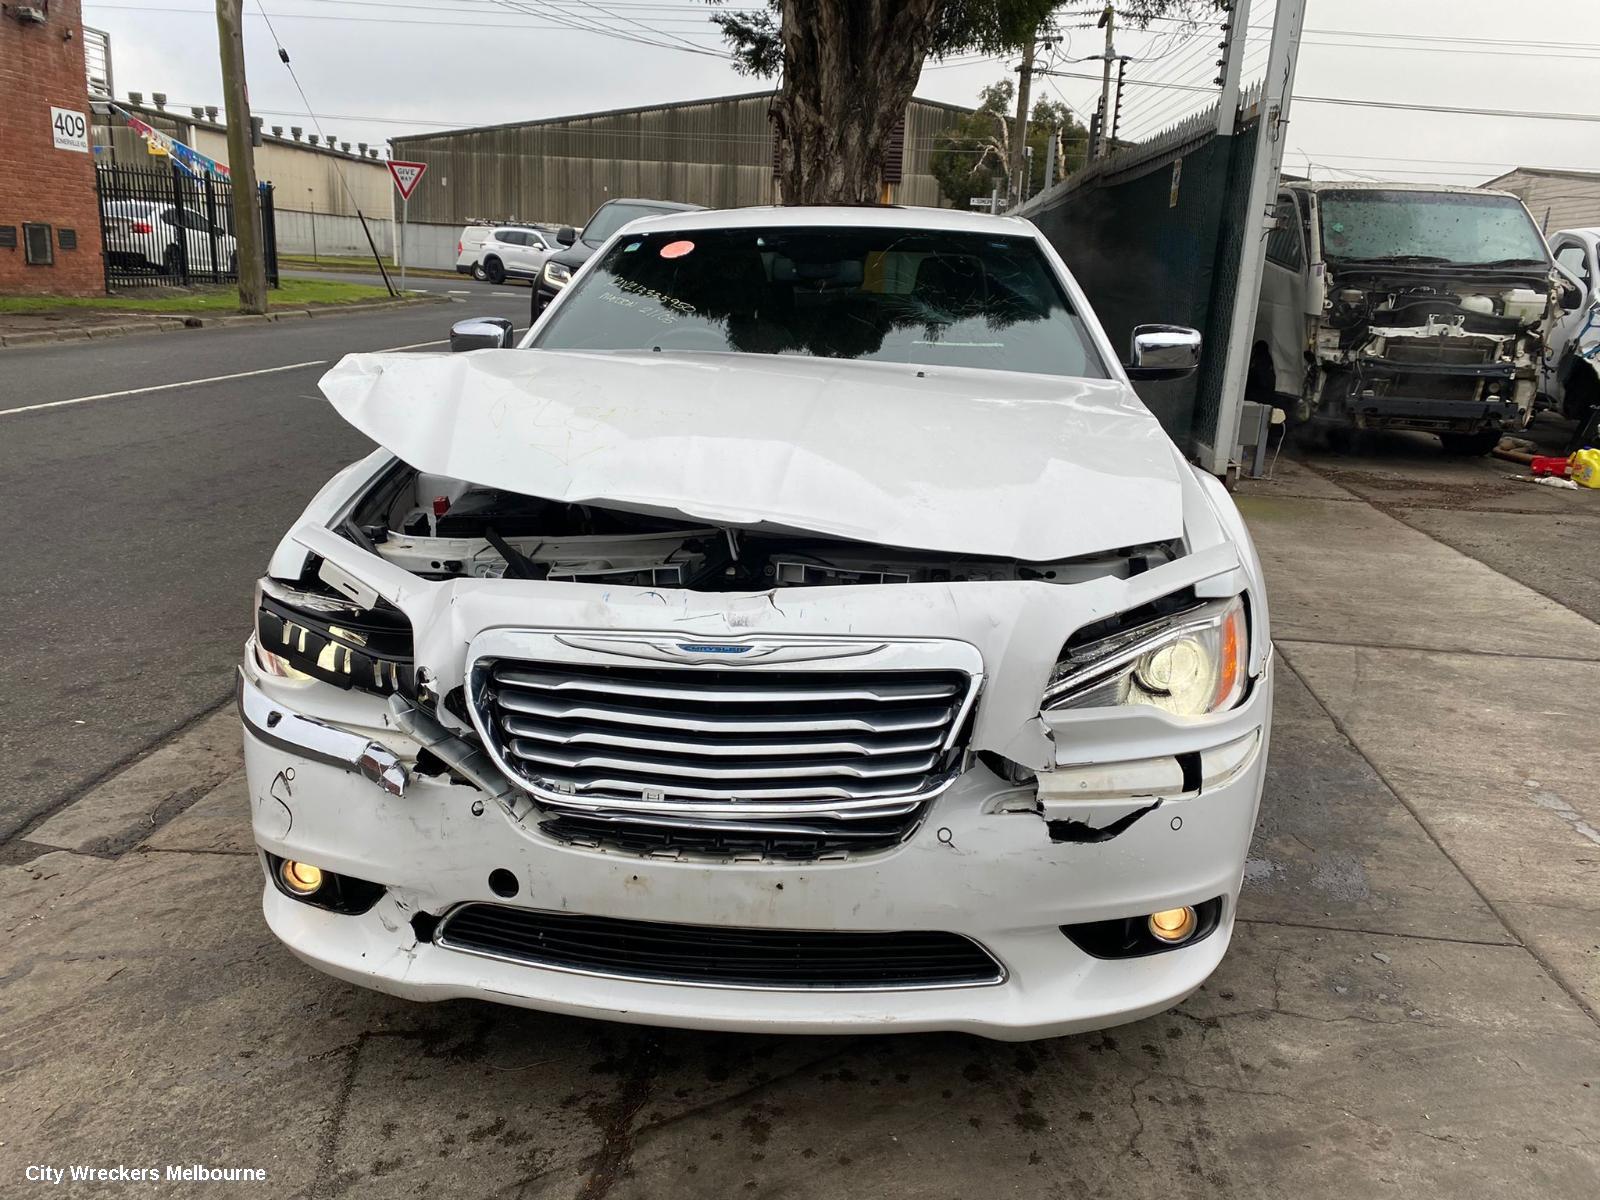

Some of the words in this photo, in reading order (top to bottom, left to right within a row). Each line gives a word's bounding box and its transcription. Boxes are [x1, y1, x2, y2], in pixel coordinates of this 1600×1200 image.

[54, 113, 85, 138] 409
[398, 168, 415, 176] GIVE
[684, 645, 748, 653] CHRYSLER
